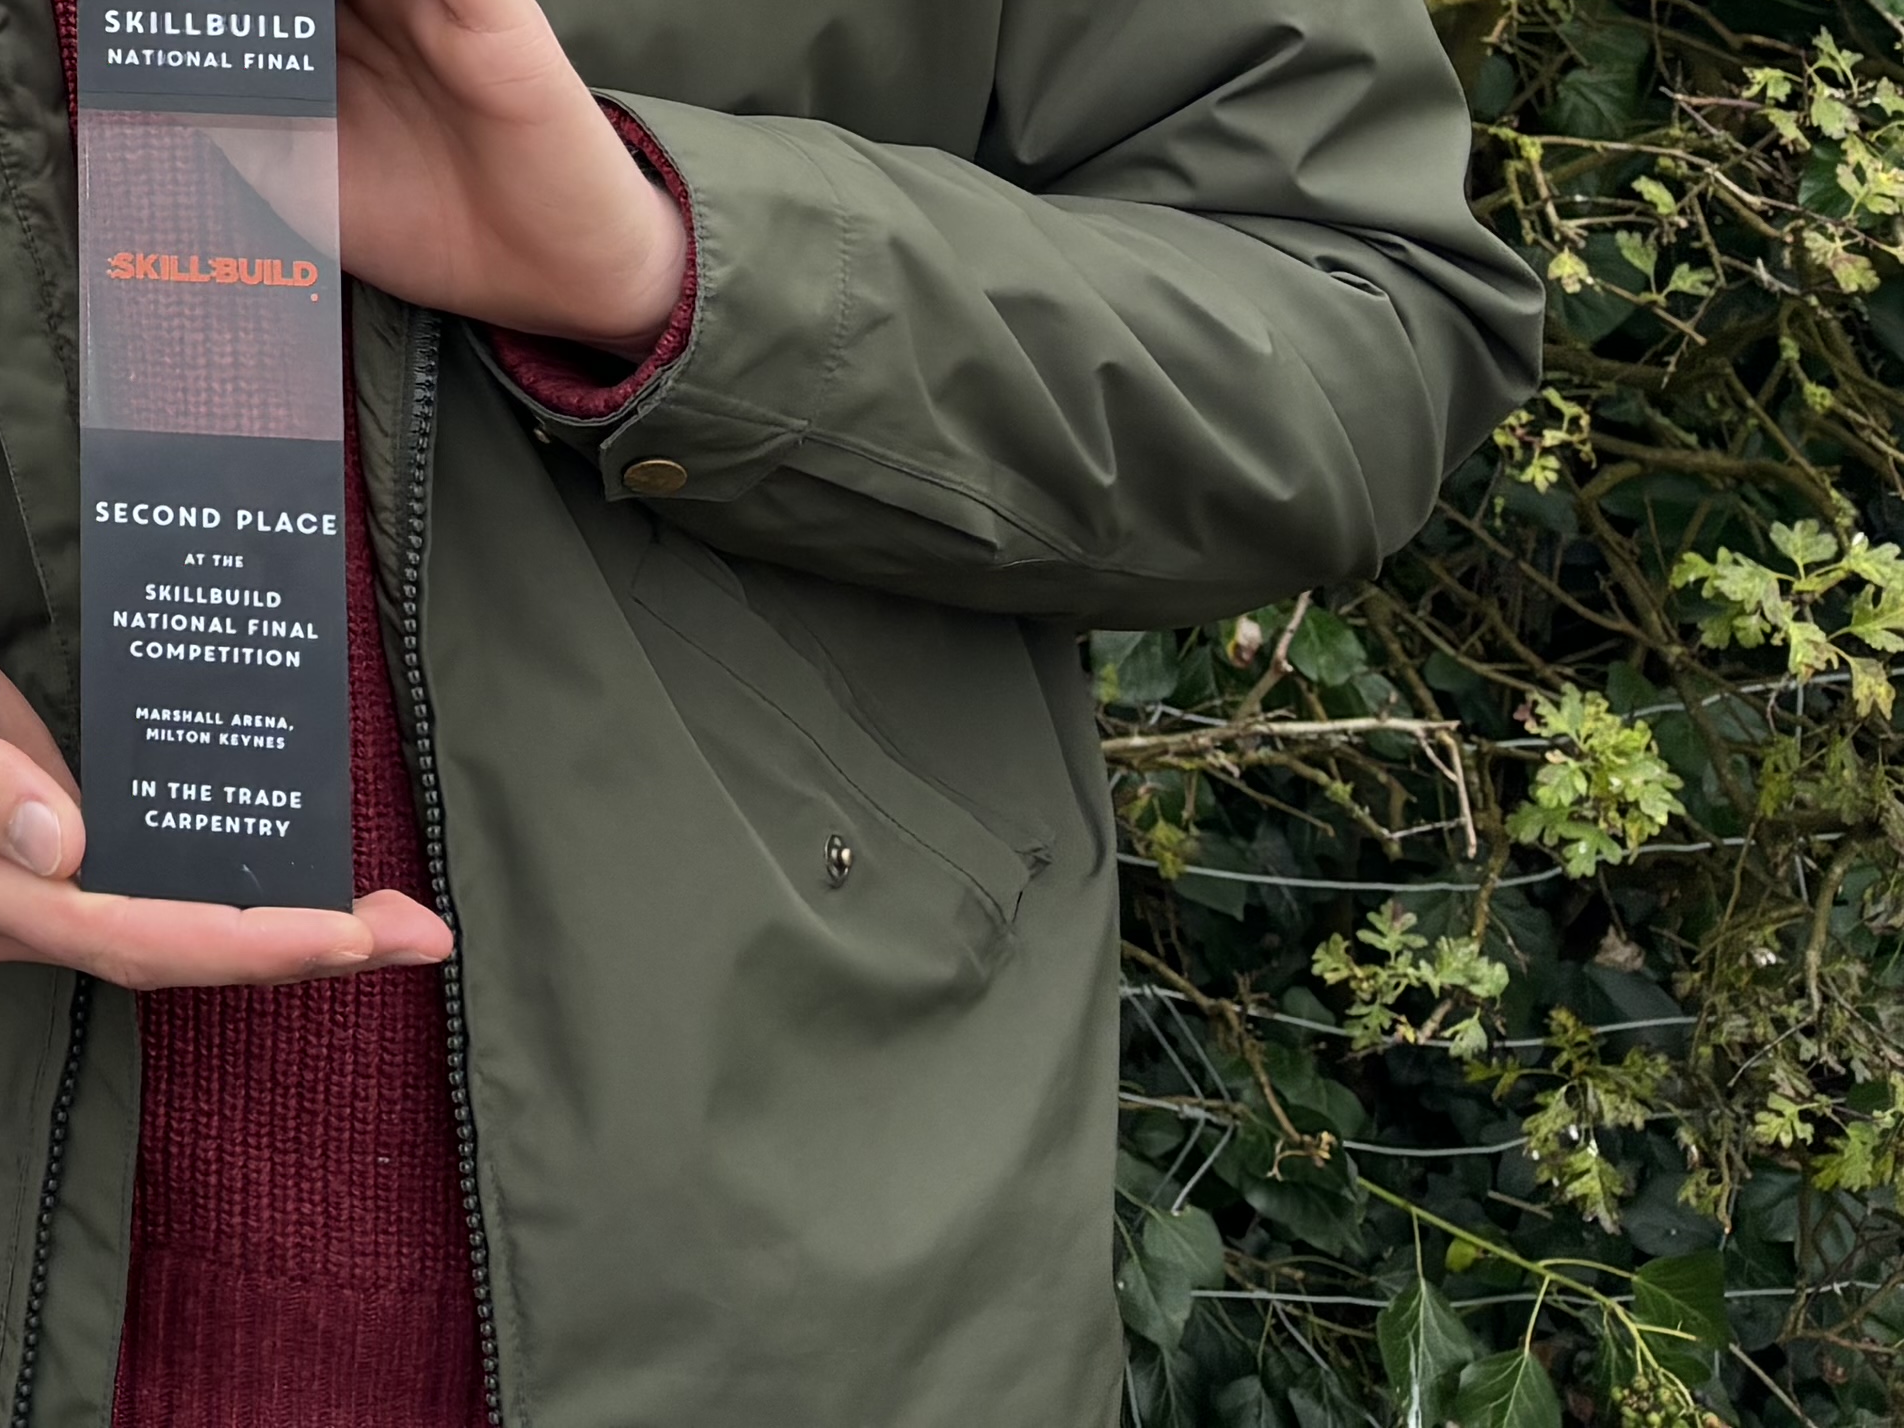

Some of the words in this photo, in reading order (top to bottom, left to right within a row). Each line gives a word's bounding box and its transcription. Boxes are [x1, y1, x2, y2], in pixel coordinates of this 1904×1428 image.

[104, 9, 316, 39] SKILLBUILD
[107, 48, 233, 69] NATIONAL
[243, 52, 315, 72] FINAL
[106, 251, 319, 287] SKILLBUILD
[94, 501, 222, 529] SECOND
[236, 509, 338, 536] PLACE
[183, 552, 206, 567] AT
[212, 554, 244, 569] THE
[144, 583, 282, 609] SKILLBUILD
[112, 610, 238, 635] NATIONAL
[247, 619, 319, 640] FINAL
[129, 640, 301, 668] COMPETITION
[135, 706, 224, 726] MARSHALL
[230, 713, 295, 732] ARENA,
[145, 727, 211, 745] MILTON
[218, 732, 286, 750] KEYNES
[131, 779, 157, 798] IN
[166, 781, 213, 802] THE
[223, 786, 303, 810] TRADE
[144, 809, 291, 838] CARPENTRY
